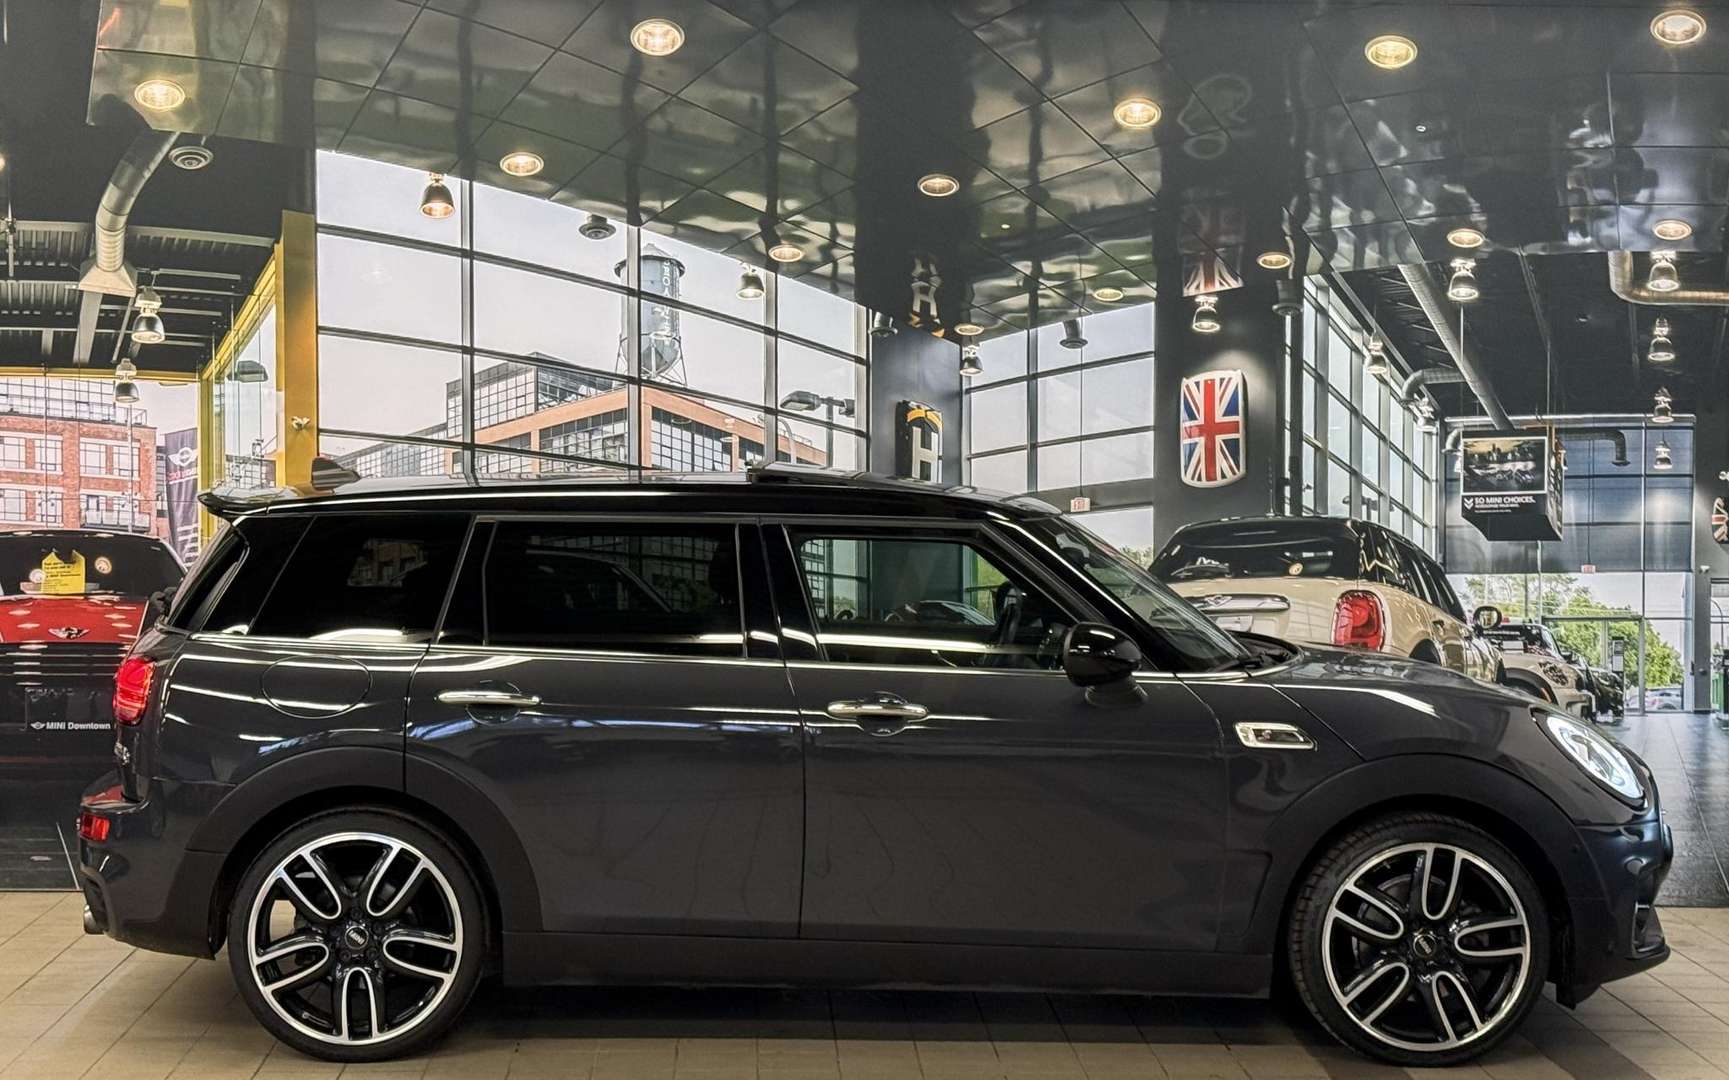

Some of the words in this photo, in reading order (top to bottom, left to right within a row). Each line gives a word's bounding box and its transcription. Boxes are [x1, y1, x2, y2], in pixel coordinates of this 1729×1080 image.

[1486, 496, 1502, 505] MINI
[46, 721, 66, 730] MINI
[67, 721, 111, 730] Downtown
